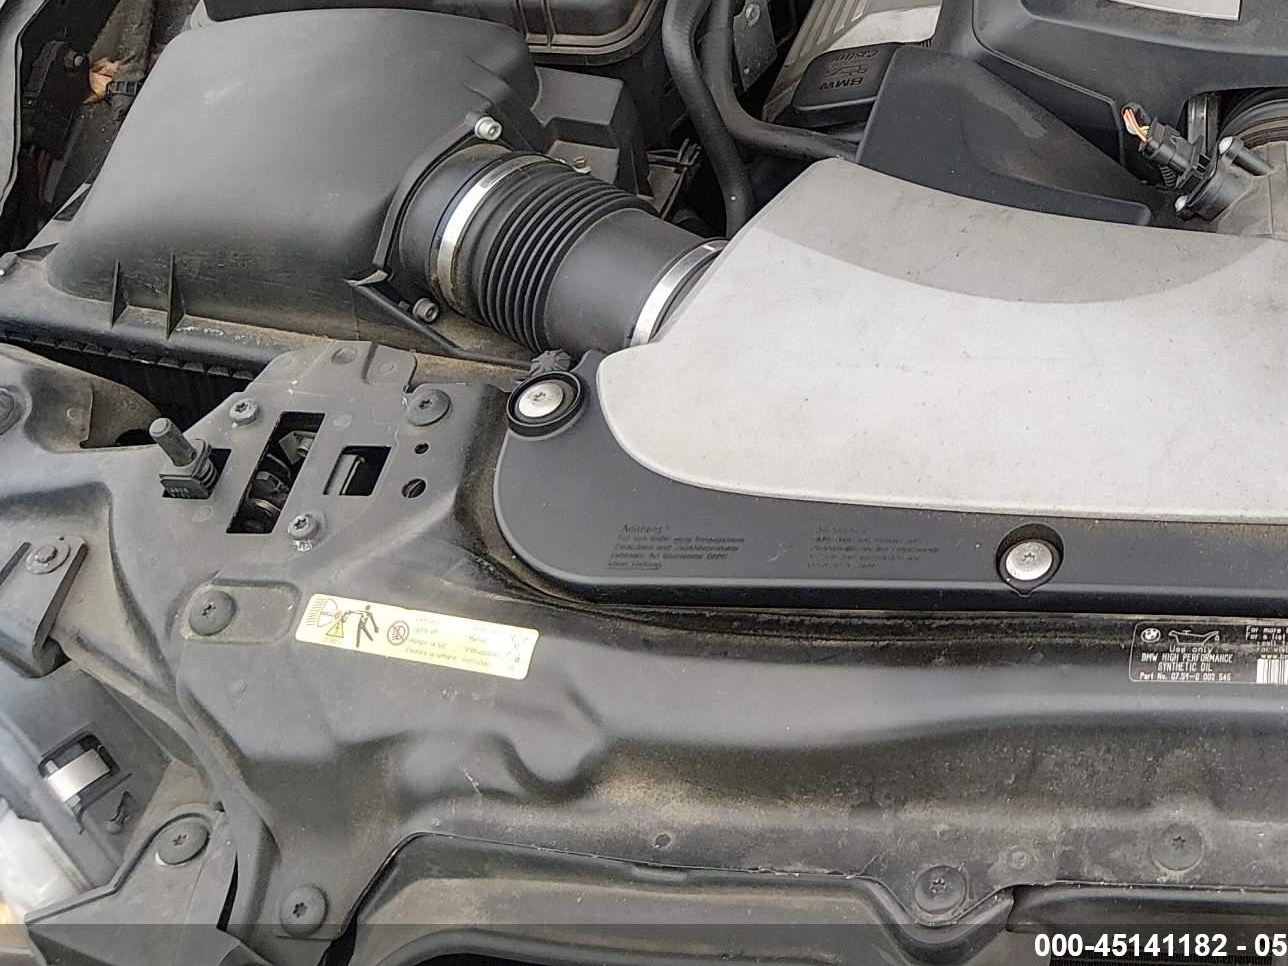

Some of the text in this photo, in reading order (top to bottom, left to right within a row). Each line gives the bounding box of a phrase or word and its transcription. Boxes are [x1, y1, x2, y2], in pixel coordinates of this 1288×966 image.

[819, 77, 864, 91] BMW
[1246, 625, 1259, 634] For
[1263, 627, 1281, 635] more
[1192, 644, 1214, 655] only
[1141, 652, 1234, 663] BMW HIGH PERFORMANCE
[1157, 661, 1213, 672] SYNTHETIC OIL
[1140, 671, 1154, 680] Part
